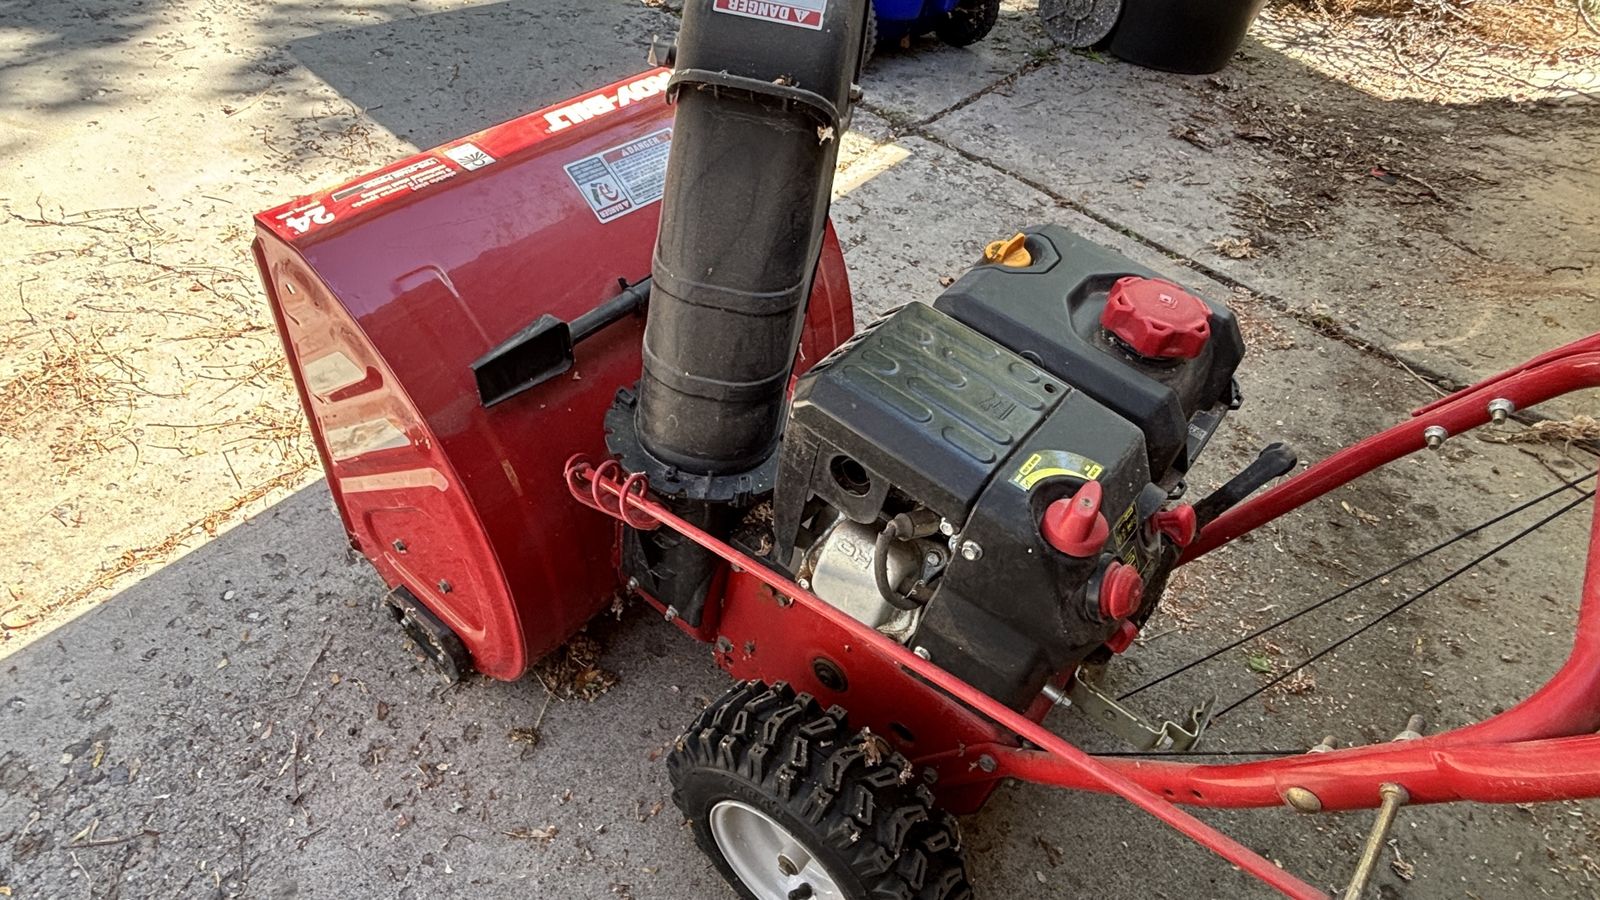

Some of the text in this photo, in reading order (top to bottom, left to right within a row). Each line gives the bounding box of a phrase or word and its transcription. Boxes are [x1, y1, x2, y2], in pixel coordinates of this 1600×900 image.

[728, 0, 789, 20] DANGER
[544, 69, 674, 133] ROY-BILT
[628, 136, 658, 153] DANGER
[286, 205, 335, 233] 24
[838, 537, 873, 570] OH
